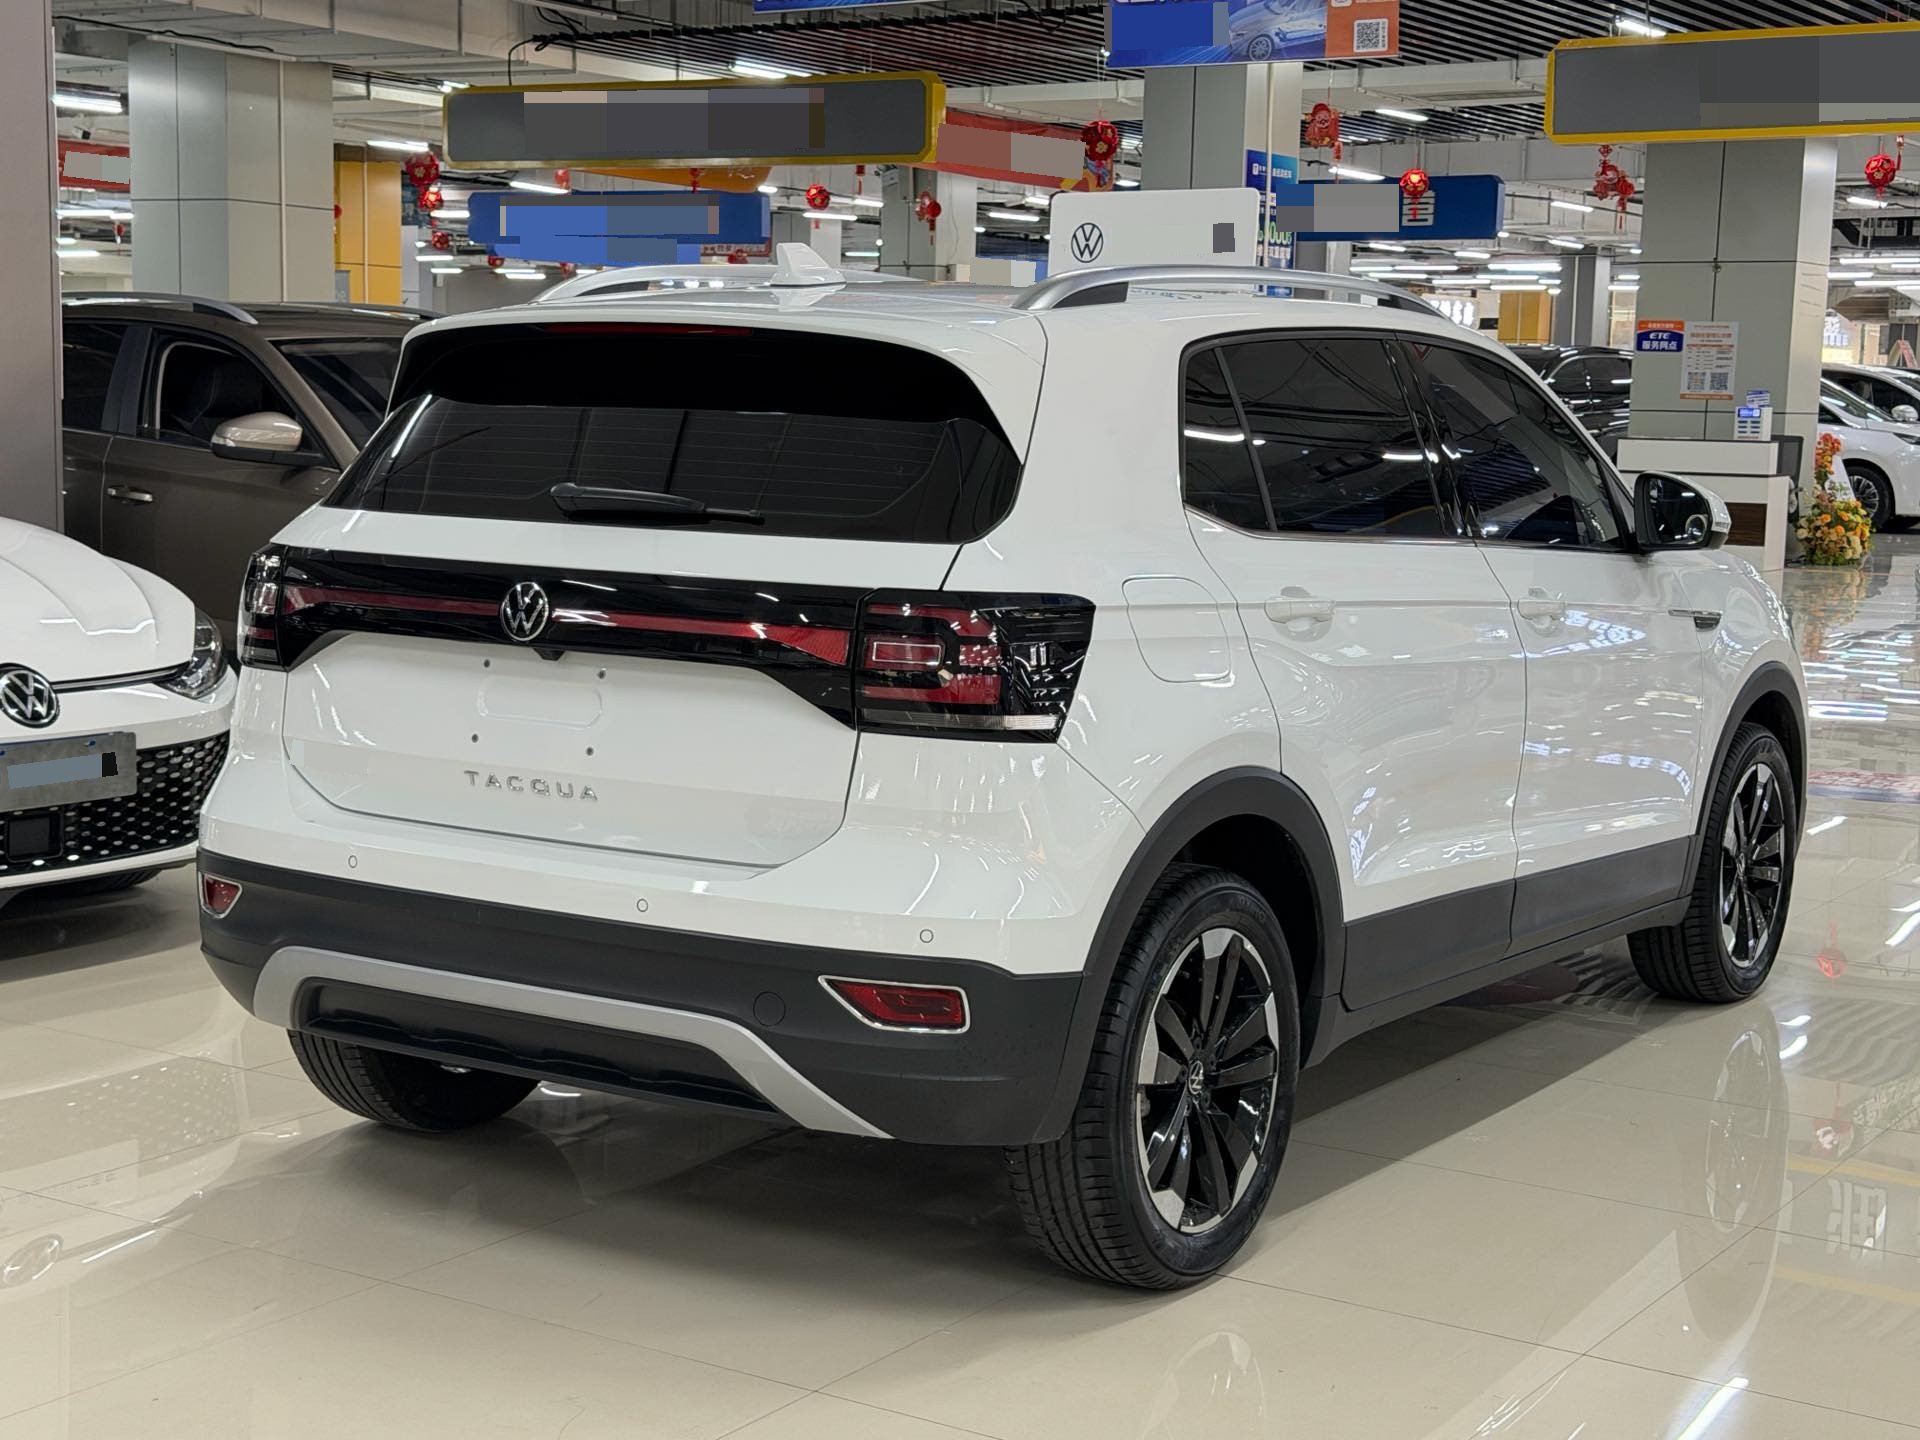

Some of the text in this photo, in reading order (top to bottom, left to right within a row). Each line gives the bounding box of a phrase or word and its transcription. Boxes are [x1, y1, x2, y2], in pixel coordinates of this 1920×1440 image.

[1071, 222, 1104, 263] VW
[1642, 340, 1678, 351] 服务网点
[500, 582, 549, 641] VW
[0, 668, 58, 726] VW
[463, 770, 599, 801] TACQUA
